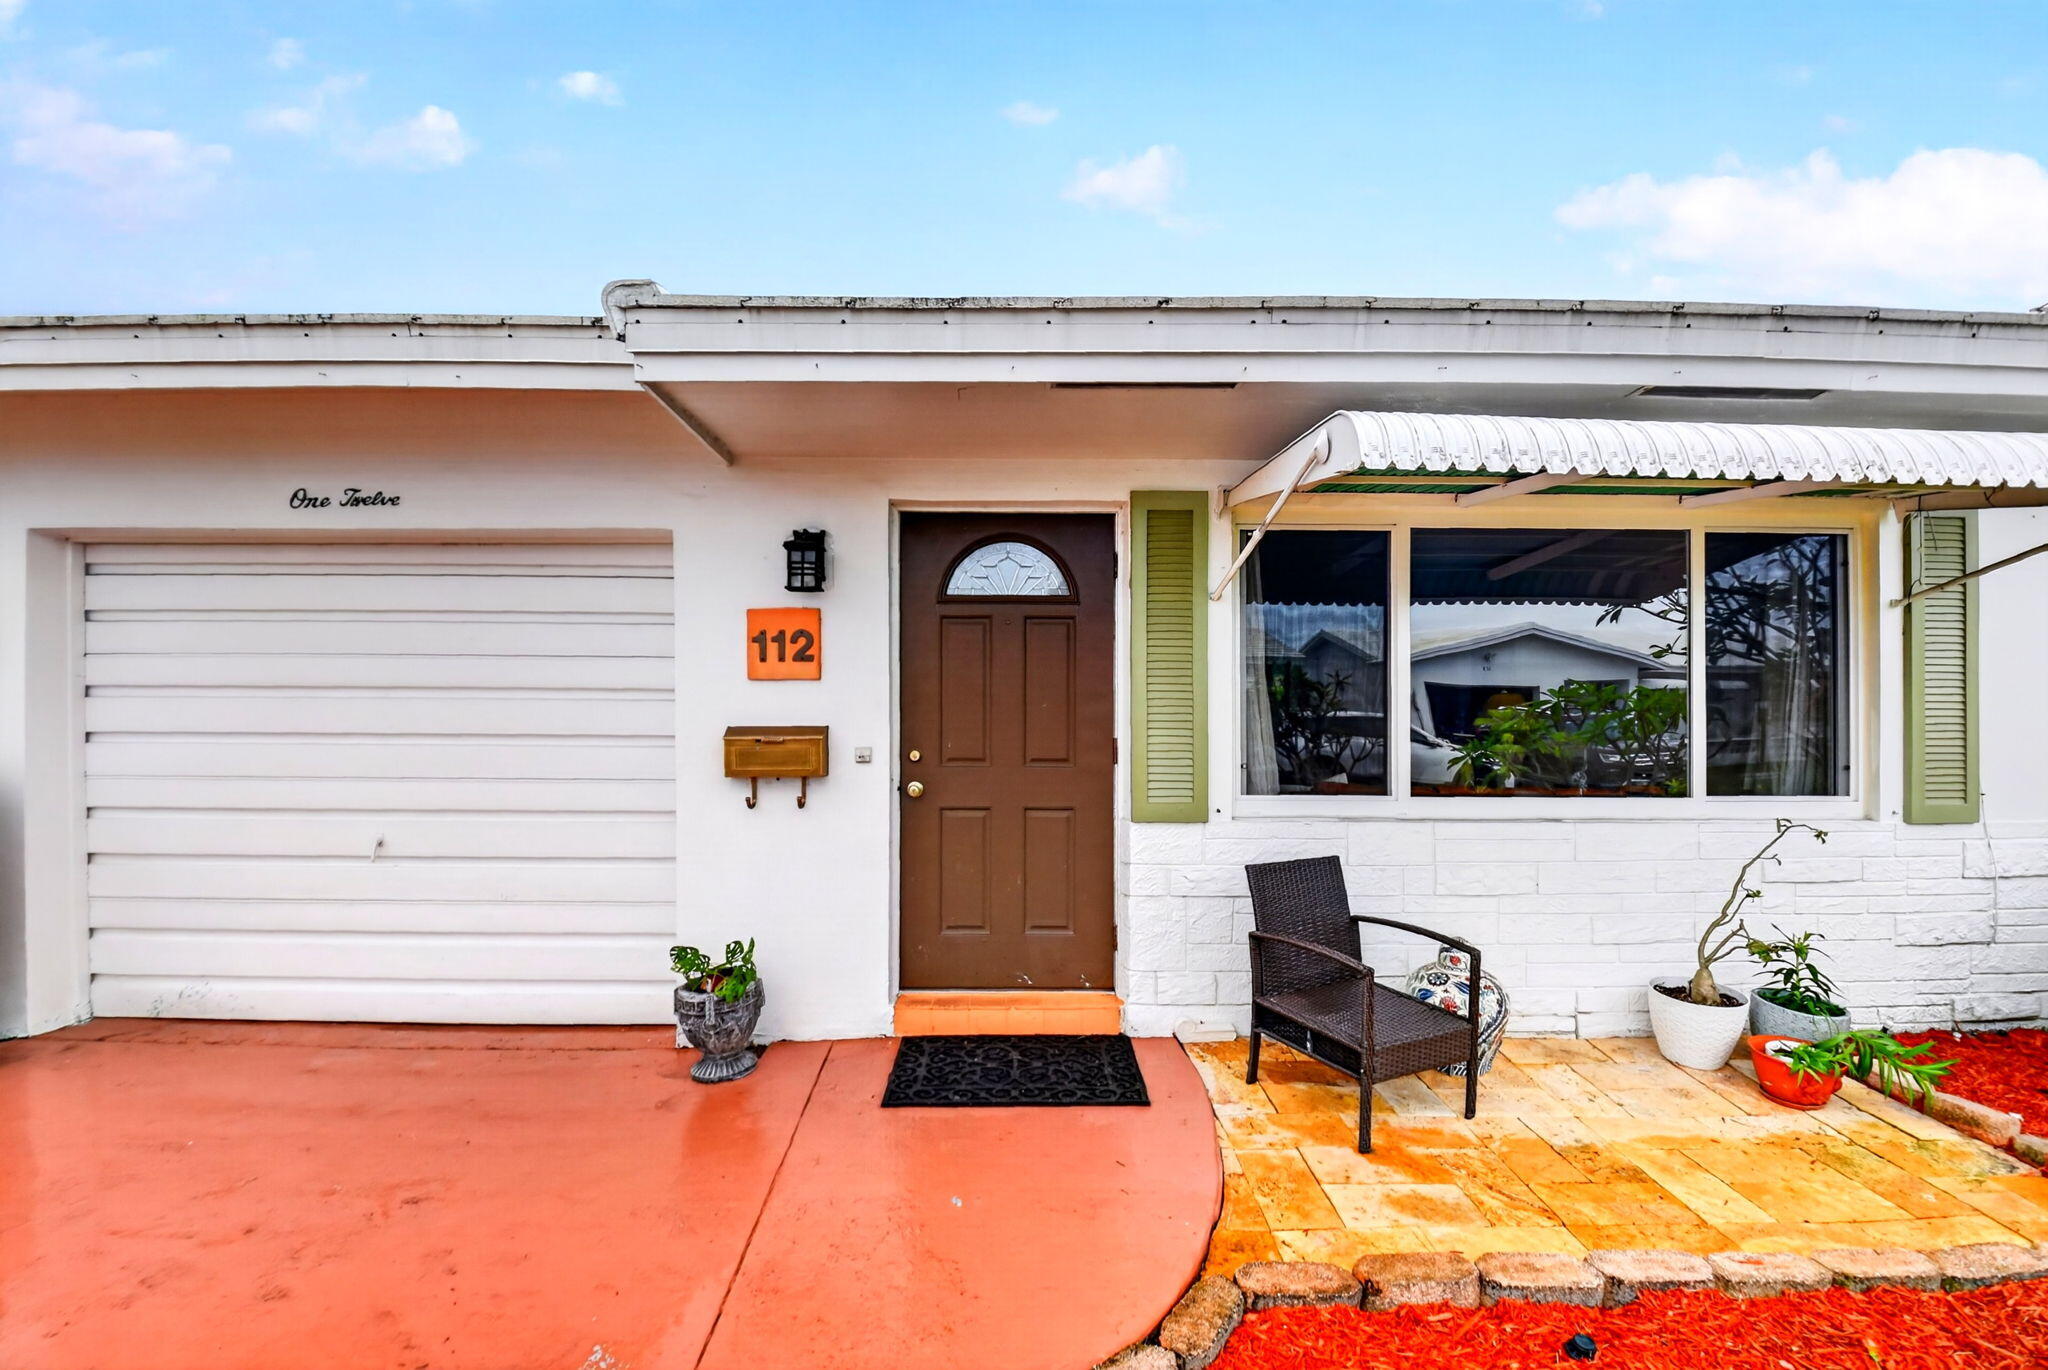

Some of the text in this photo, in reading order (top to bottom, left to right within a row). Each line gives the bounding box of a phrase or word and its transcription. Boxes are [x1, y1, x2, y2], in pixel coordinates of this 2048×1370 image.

[289, 487, 401, 509] One Twelve
[751, 629, 815, 663] 112
